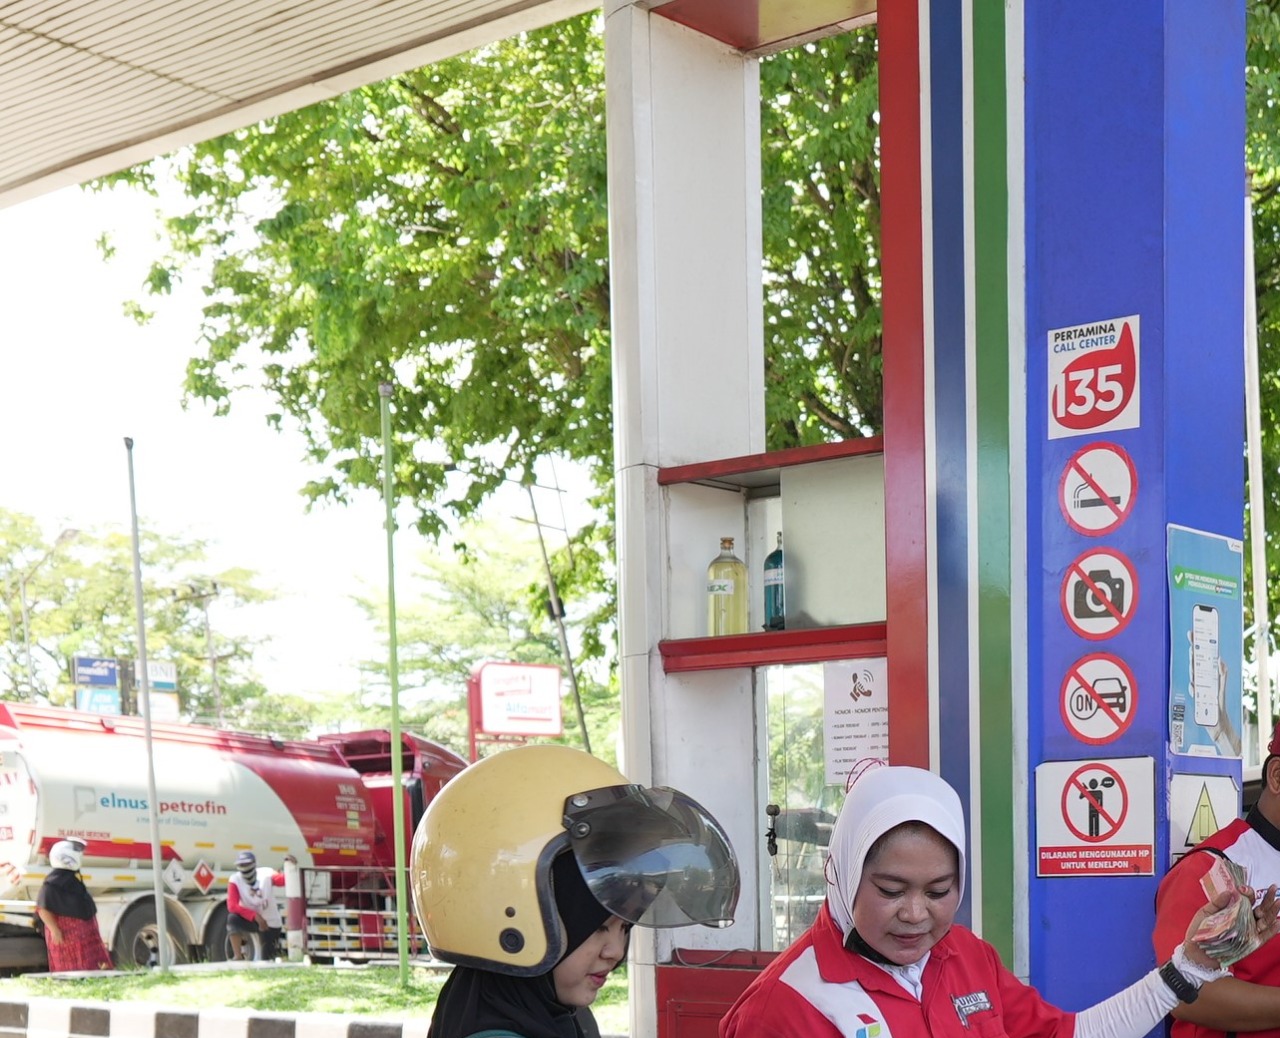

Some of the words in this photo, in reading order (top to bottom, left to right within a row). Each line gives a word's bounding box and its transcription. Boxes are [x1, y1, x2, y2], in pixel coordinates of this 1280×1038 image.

[1054, 323, 1116, 342] PERTAMINA
[1054, 341, 1076, 354] CALL
[1079, 334, 1116, 349] CENTER
[1057, 363, 1124, 418] 135
[1076, 693, 1093, 712] ON
[100, 793, 149, 810] elnus
[159, 799, 227, 815] petrofin
[1041, 851, 1077, 859] DILARANG
[1079, 849, 1137, 858] MENGGUNAKAN
[1138, 849, 1150, 857] HP
[1061, 861, 1087, 869] UNTUK
[1087, 860, 1129, 869] MENELPON
